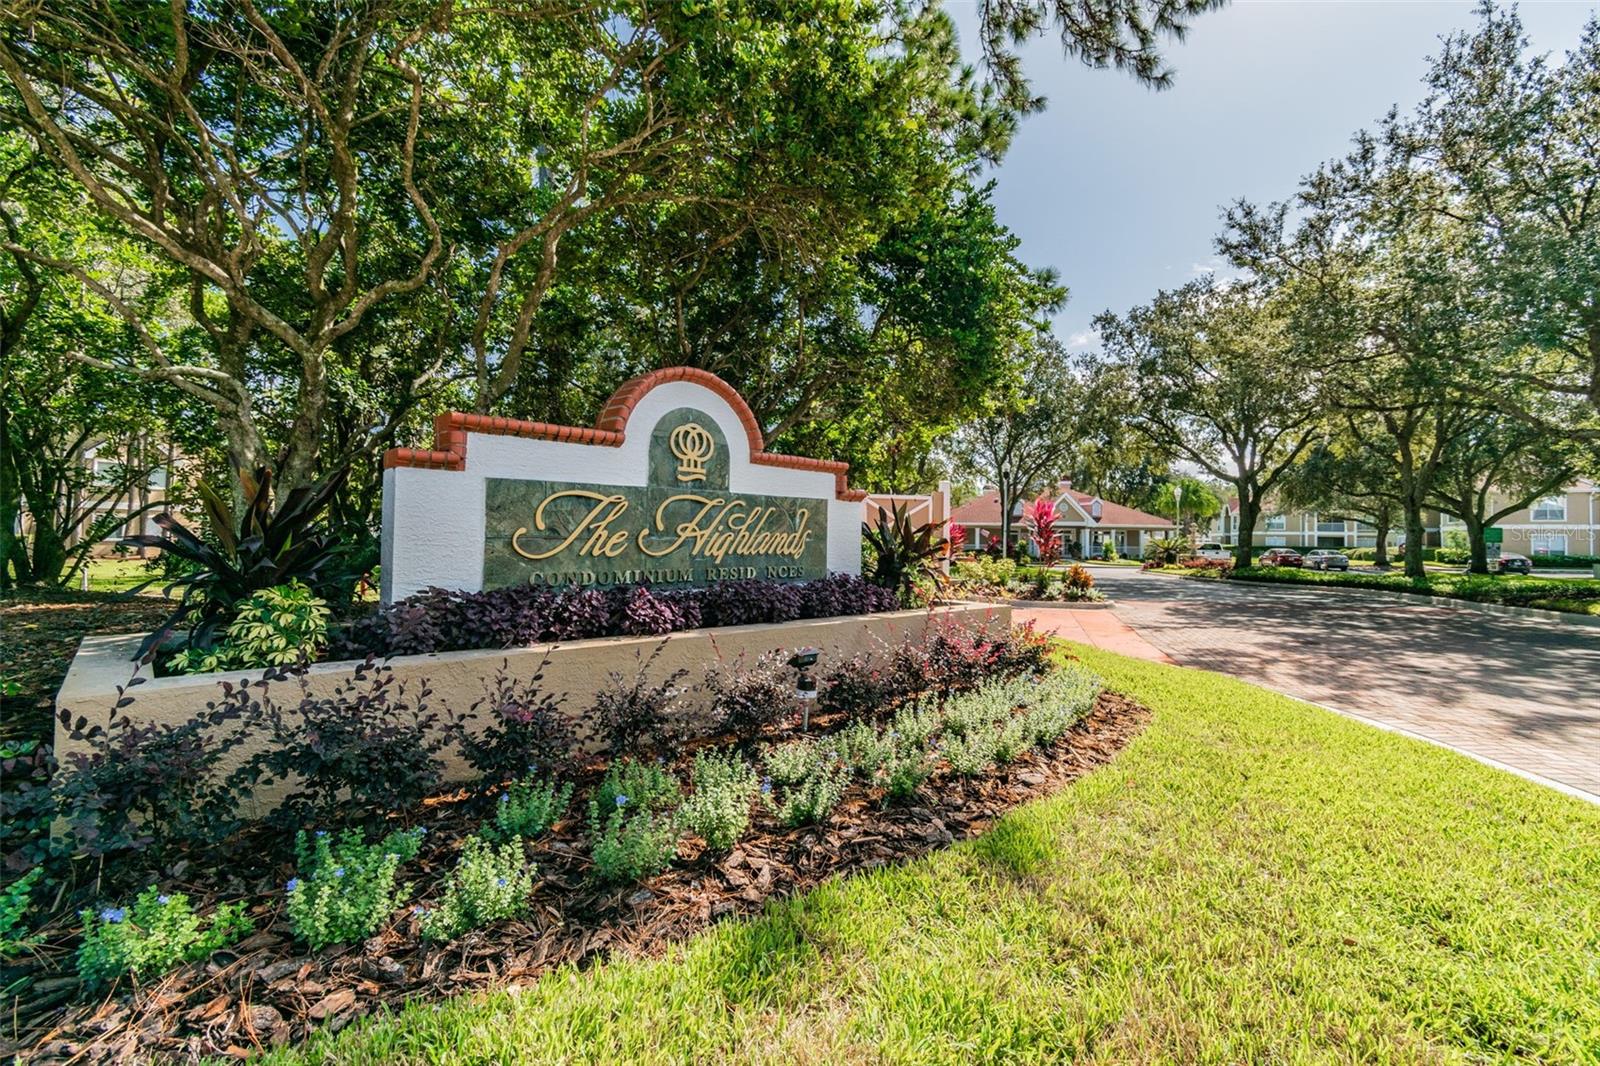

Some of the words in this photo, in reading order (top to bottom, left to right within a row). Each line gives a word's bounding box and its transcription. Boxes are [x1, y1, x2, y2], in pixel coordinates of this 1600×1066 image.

[512, 489, 629, 560] The
[638, 494, 811, 565] Highlands
[529, 568, 694, 587] CONDOMINIUM
